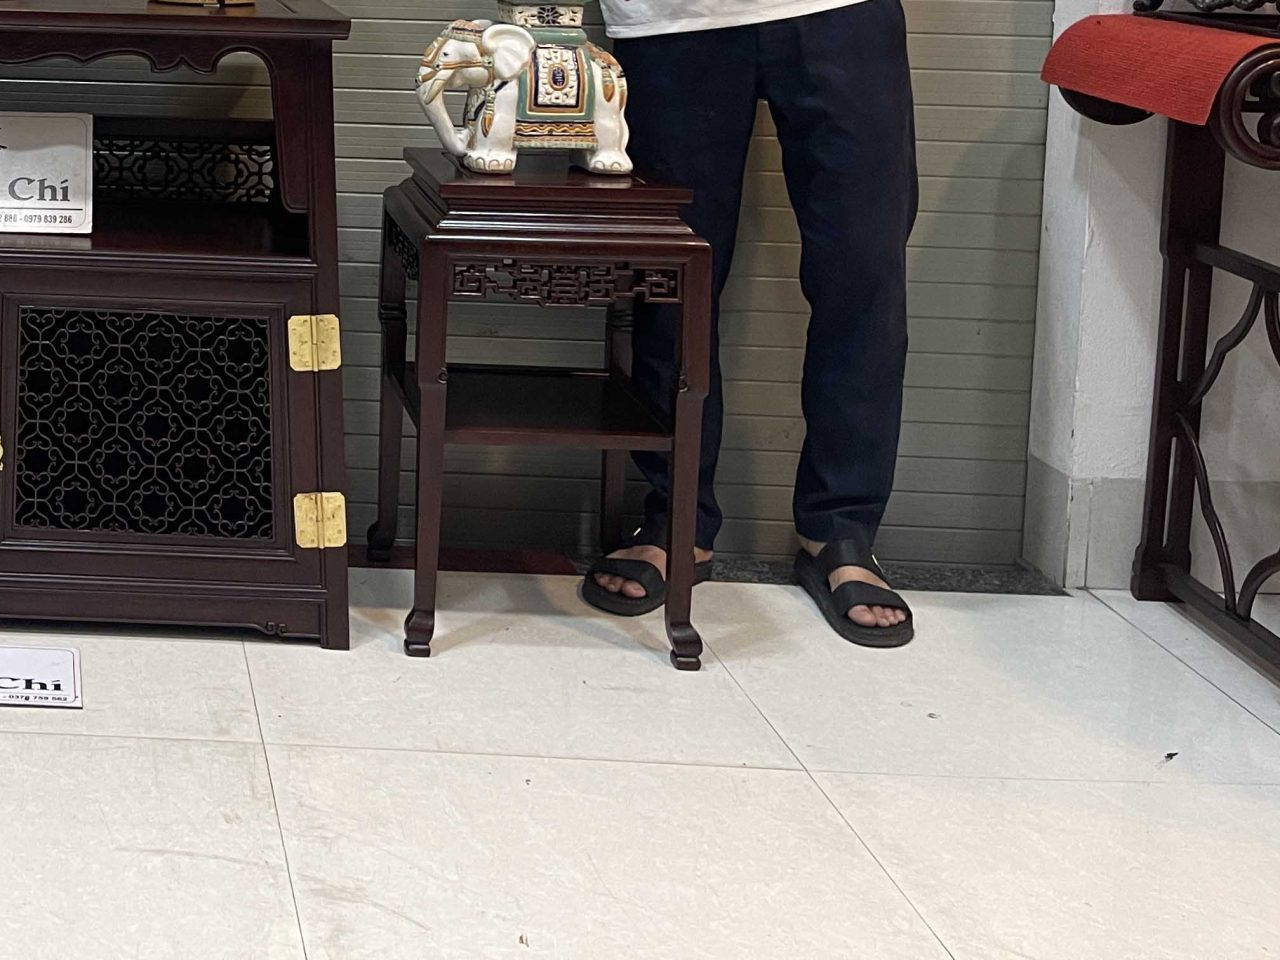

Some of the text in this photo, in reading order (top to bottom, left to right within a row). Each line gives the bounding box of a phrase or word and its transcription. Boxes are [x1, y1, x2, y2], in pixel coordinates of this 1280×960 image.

[8, 177, 71, 202] Chí
[23, 214, 42, 224] 0979
[43, 214, 57, 224] 839
[58, 215, 73, 224] 286
